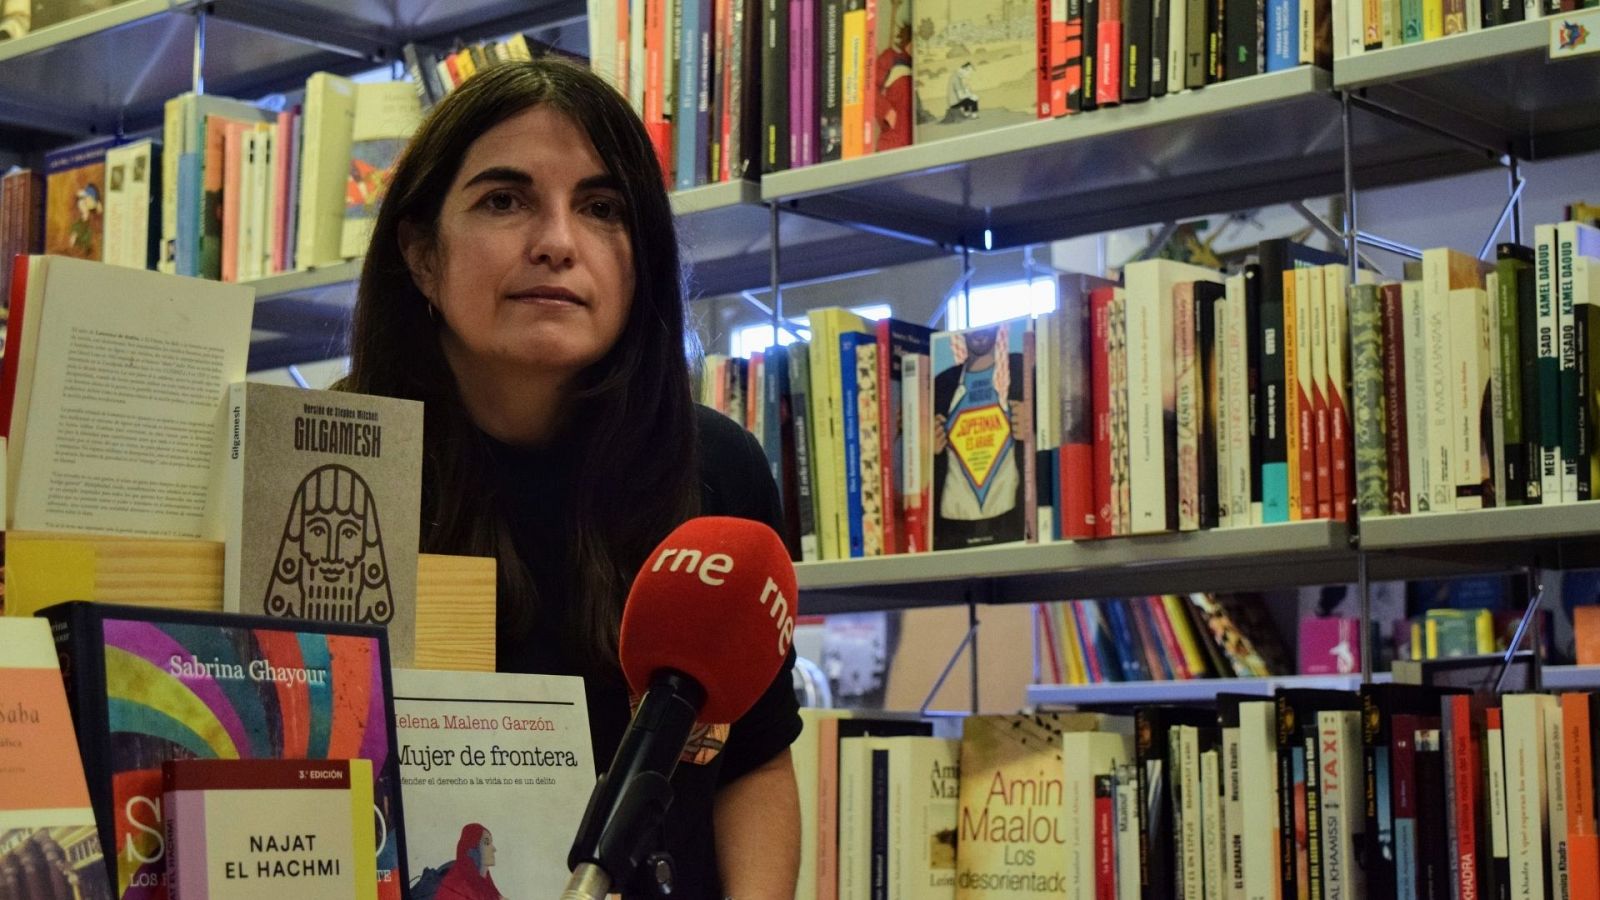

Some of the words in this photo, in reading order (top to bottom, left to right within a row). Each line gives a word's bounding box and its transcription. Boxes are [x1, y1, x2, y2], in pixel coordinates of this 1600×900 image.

[1538, 243, 1550, 280] DAOUD
[1561, 241, 1573, 277] DAOUD
[1539, 282, 1551, 317] KAMEL
[1562, 280, 1574, 315] KAMEL
[1540, 326, 1552, 357] SADO
[1563, 325, 1575, 369] EVISADO
[303, 404, 325, 415] Versión
[326, 406, 333, 416] de
[334, 407, 356, 420] Stephen
[357, 409, 378, 421] Mitchell
[957, 415, 1004, 437] SUPERMAN
[1390, 403, 1399, 437] BLANCO
[231, 406, 241, 460] Gilgamesh
[294, 416, 382, 458] GILGAMESH
[651, 547, 734, 586] rne
[758, 576, 795, 656] rne
[170, 654, 245, 681] Sabrina
[249, 660, 326, 689] Ghayour
[443, 714, 499, 731] Maleno
[502, 716, 555, 732] Garzón
[460, 745, 486, 767] de
[490, 745, 578, 768] frontera
[1323, 729, 1338, 794] TAXI
[310, 769, 343, 780] EDICIÓN
[400, 776, 427, 786] fender
[428, 777, 435, 786] el
[436, 777, 468, 786] derecho
[469, 778, 475, 786] a
[475, 777, 484, 786] la
[485, 777, 502, 786] vida
[503, 778, 513, 786] no
[514, 778, 524, 786] es
[524, 778, 535, 786] un
[535, 777, 556, 786] delito
[987, 770, 1063, 806] Amin
[961, 806, 1066, 844] Maalou
[1118, 793, 1128, 833] Maalouf
[166, 818, 175, 866] HACHMI
[249, 834, 316, 852] NAJAT
[1004, 844, 1036, 866] Los
[1232, 834, 1243, 878] CAPARAZÓN
[1327, 816, 1340, 882] KHAMISSI
[1557, 841, 1567, 871] Khadra
[129, 872, 158, 888] LOS
[225, 861, 249, 879] EL
[257, 859, 340, 878] HACHMI
[959, 870, 1066, 893] desorientad
[1461, 853, 1474, 900] KHADRA
[1520, 861, 1530, 895] Khadra
